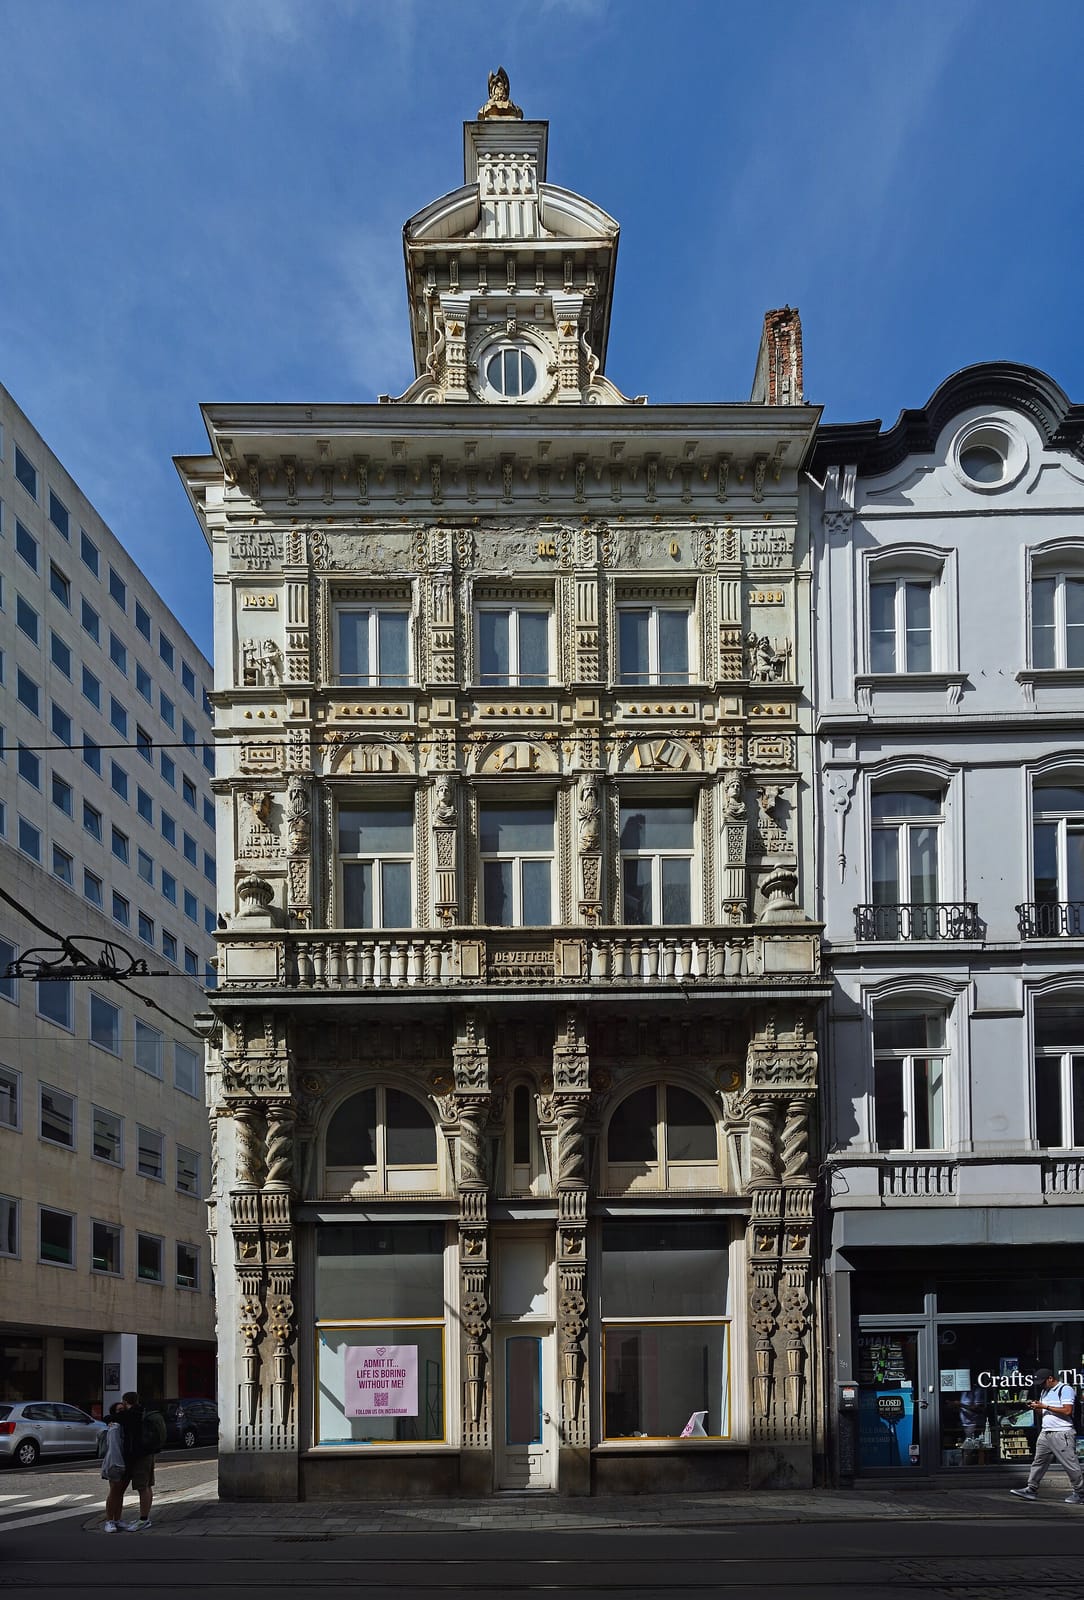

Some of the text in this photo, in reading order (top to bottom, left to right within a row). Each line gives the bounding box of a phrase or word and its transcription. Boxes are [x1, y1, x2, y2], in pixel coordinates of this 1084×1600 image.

[238, 533, 275, 545] ET LA
[752, 529, 786, 541] ET LA
[230, 544, 284, 559] LUMIERE
[741, 541, 794, 555] LUMIERE
[246, 558, 271, 570] FUT
[752, 554, 783, 567] LUIT
[751, 591, 783, 603] 1880
[245, 835, 280, 847] NE ME
[770, 830, 786, 840] ME
[238, 848, 287, 859] RESISTE
[363, 1359, 399, 1368] ADMIT IT...
[356, 1369, 406, 1379] LIFE IS BORING
[977, 1370, 1034, 1388] Crafts
[359, 1380, 404, 1389] WITHOUT ME!
[879, 1399, 902, 1407] CLOSED
